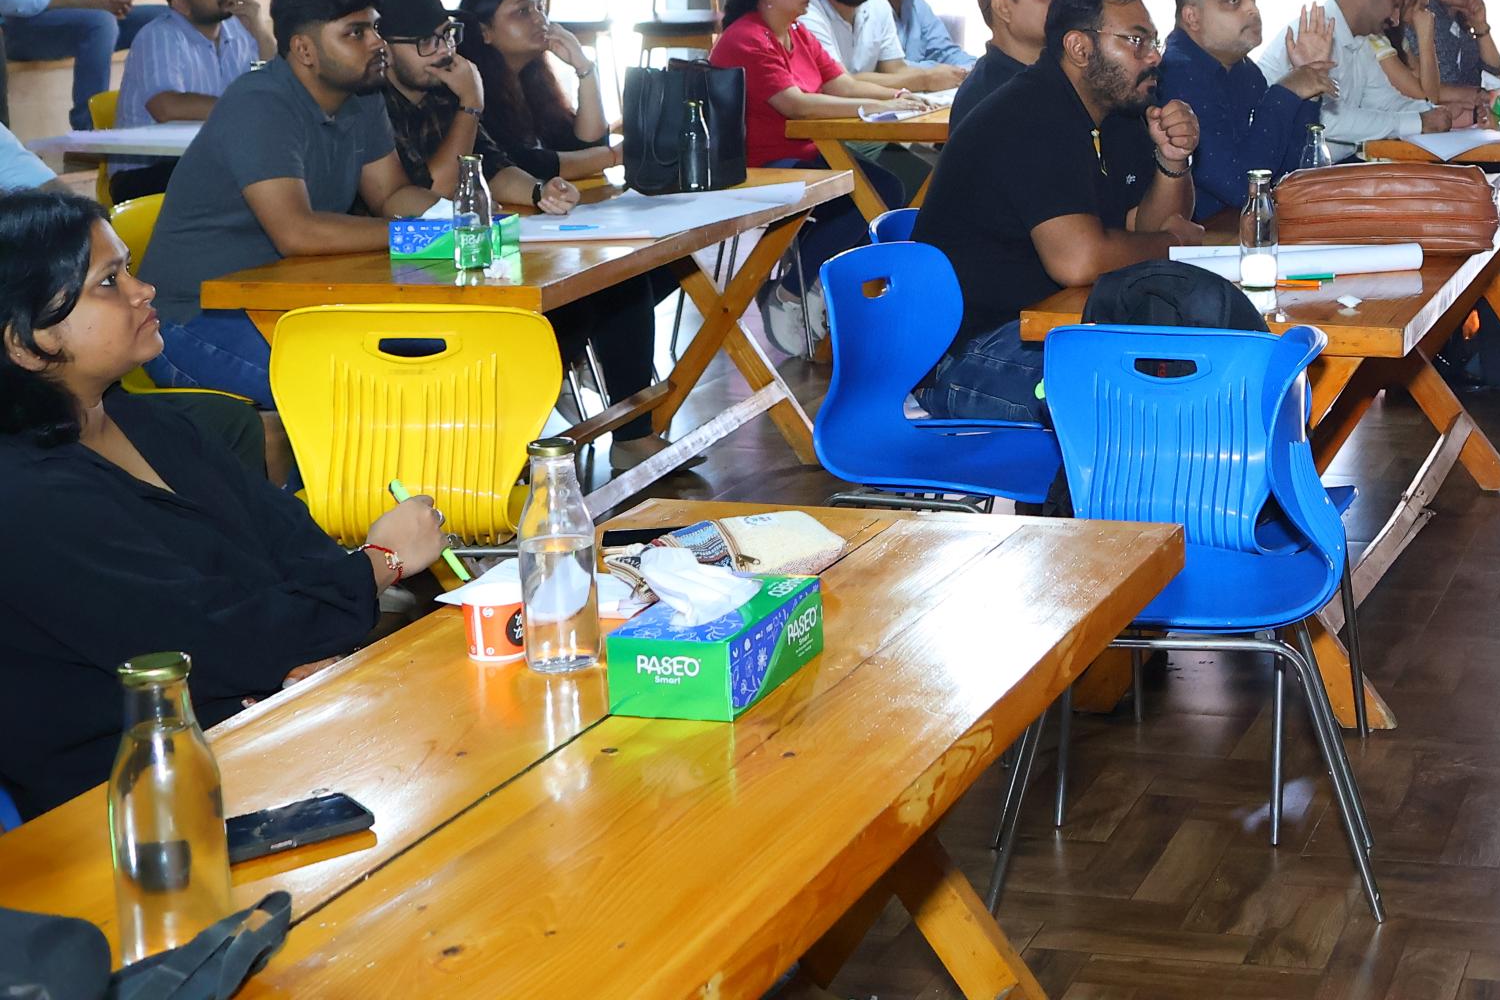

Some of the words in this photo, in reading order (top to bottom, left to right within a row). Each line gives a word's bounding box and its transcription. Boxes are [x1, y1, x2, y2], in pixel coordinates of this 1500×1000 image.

[787, 606, 817, 646] PASEO
[636, 654, 701, 677] PASEO
[654, 675, 681, 685] Smart
